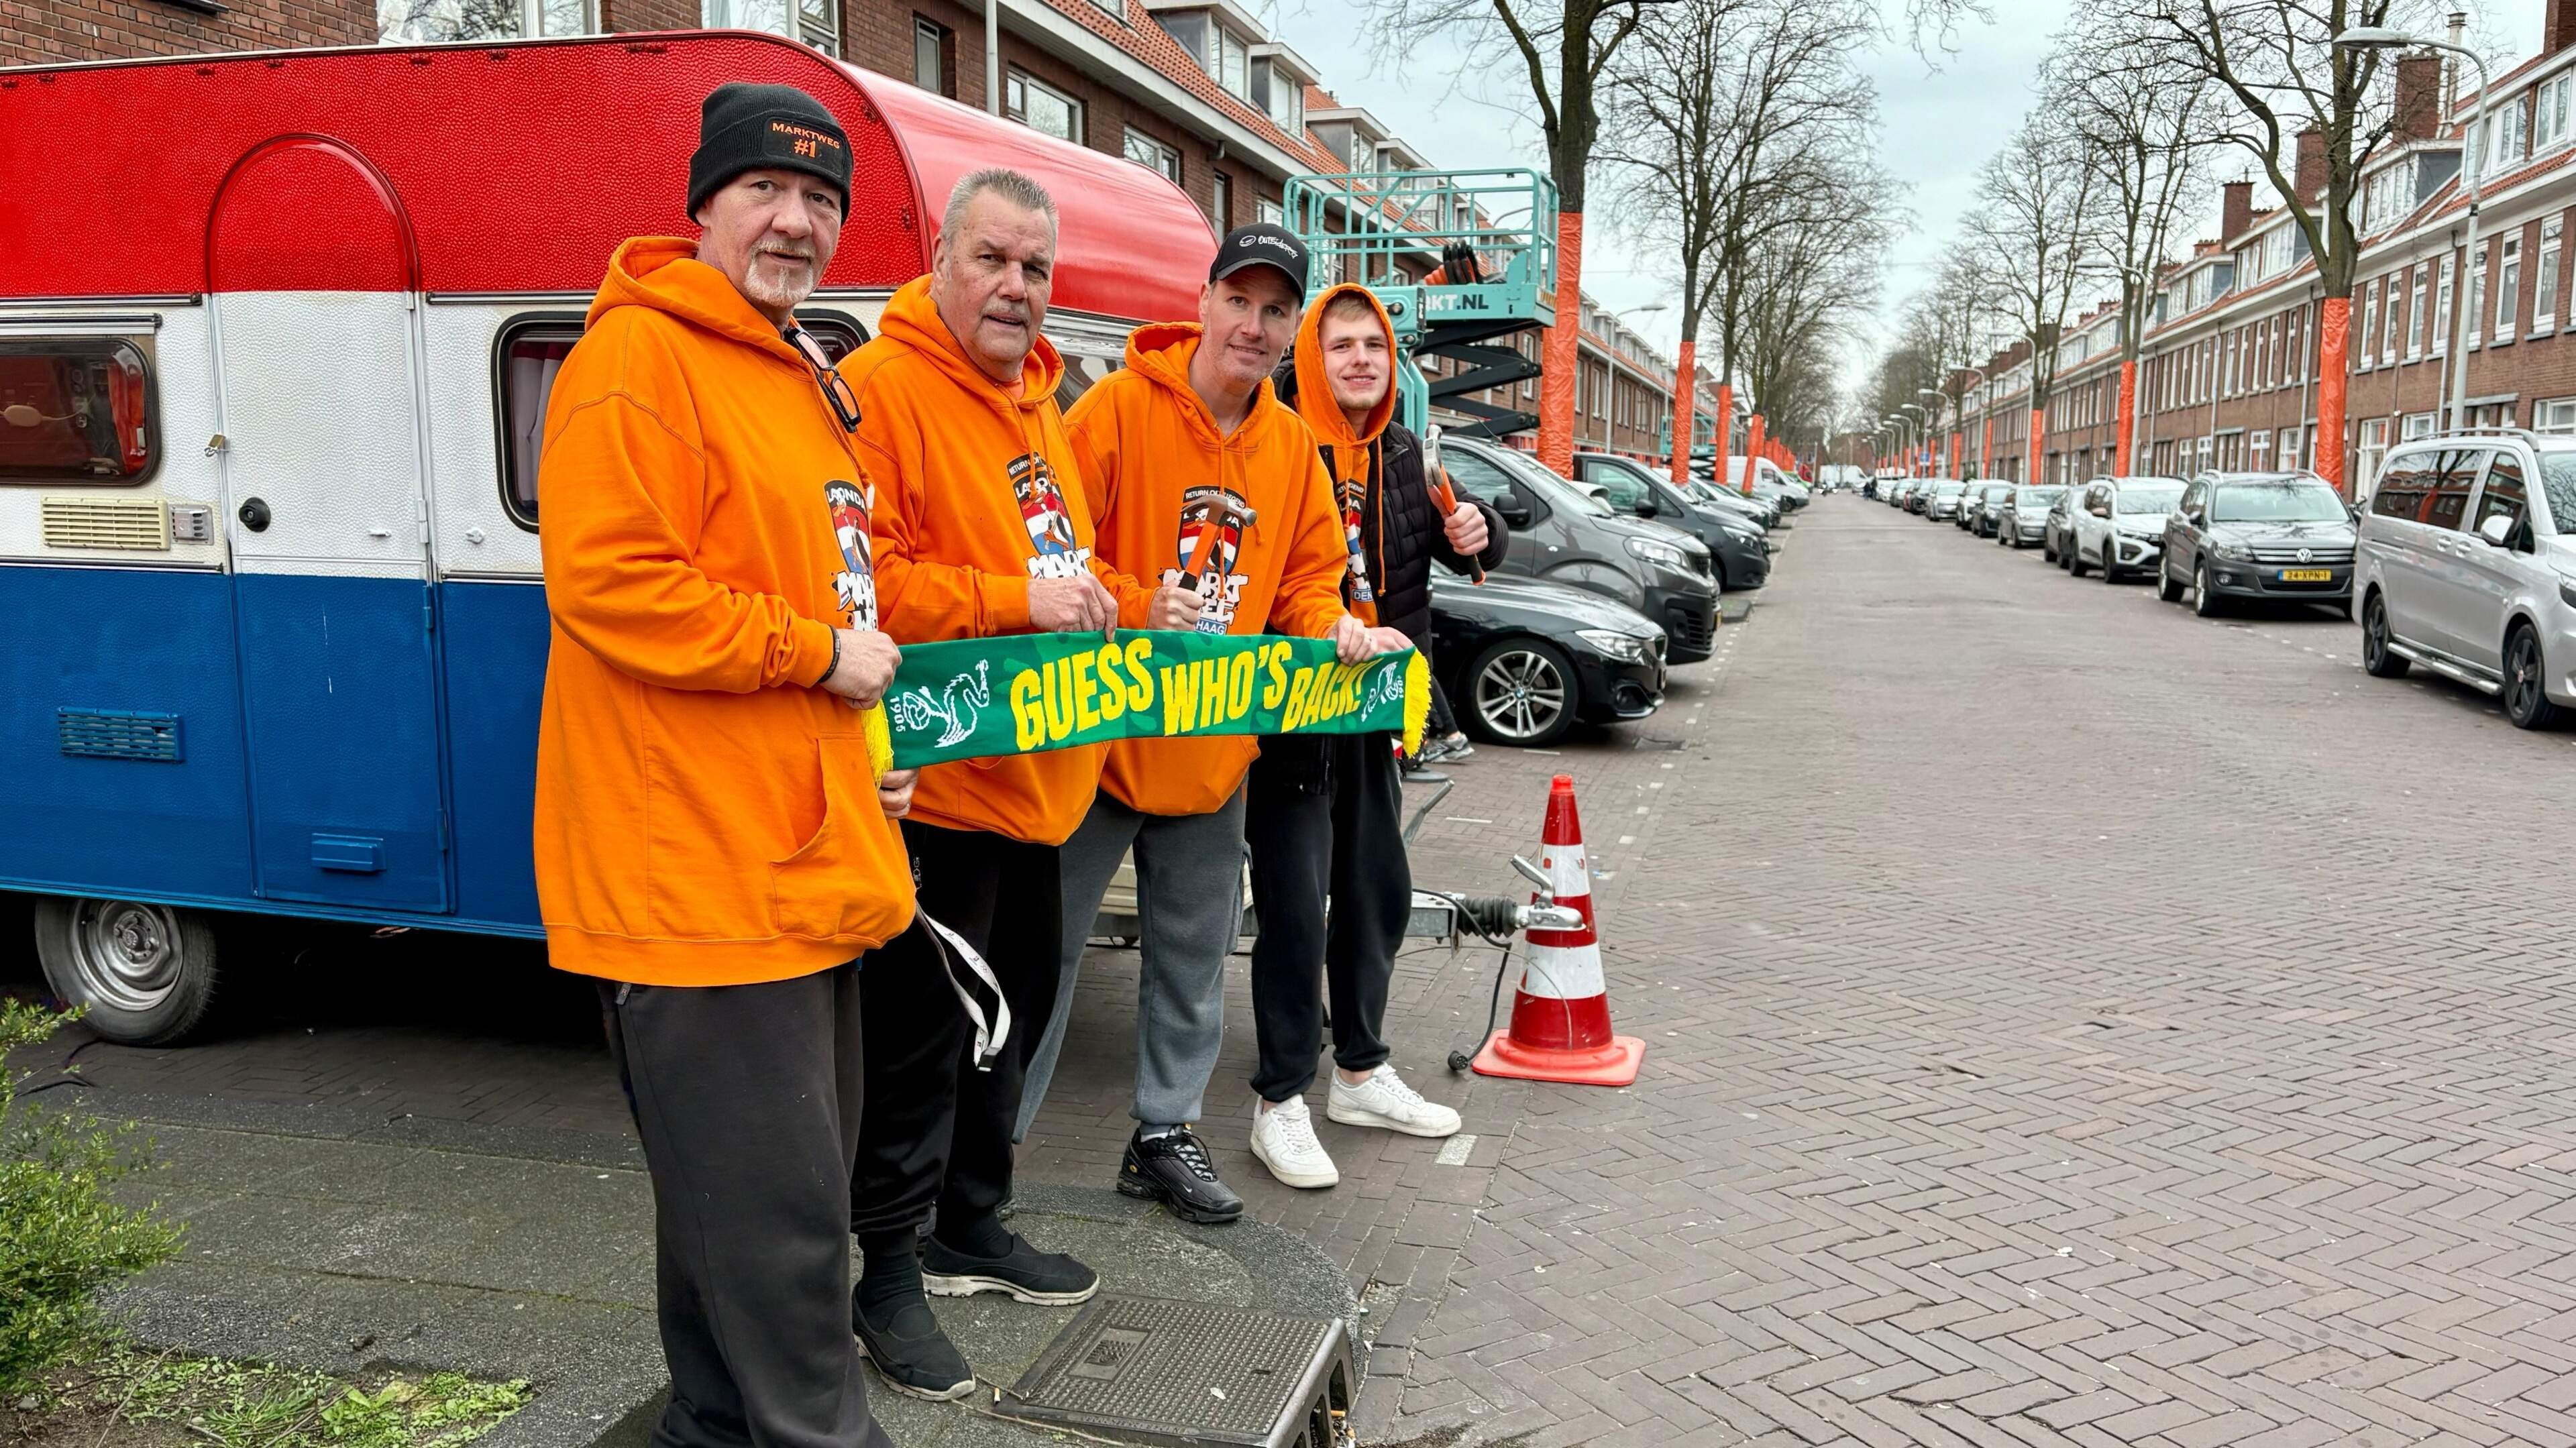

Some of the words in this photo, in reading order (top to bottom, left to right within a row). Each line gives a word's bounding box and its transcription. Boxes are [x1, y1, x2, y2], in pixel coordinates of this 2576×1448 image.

[772, 122, 840, 149] MARKTWEG
[794, 138, 816, 158] #1
[1185, 490, 1209, 499] RETURN
[1195, 620, 1226, 635] HAAG
[1010, 638, 1154, 751] GUESS
[1160, 641, 1292, 736] WHO'S
[890, 696, 906, 732] 1905
